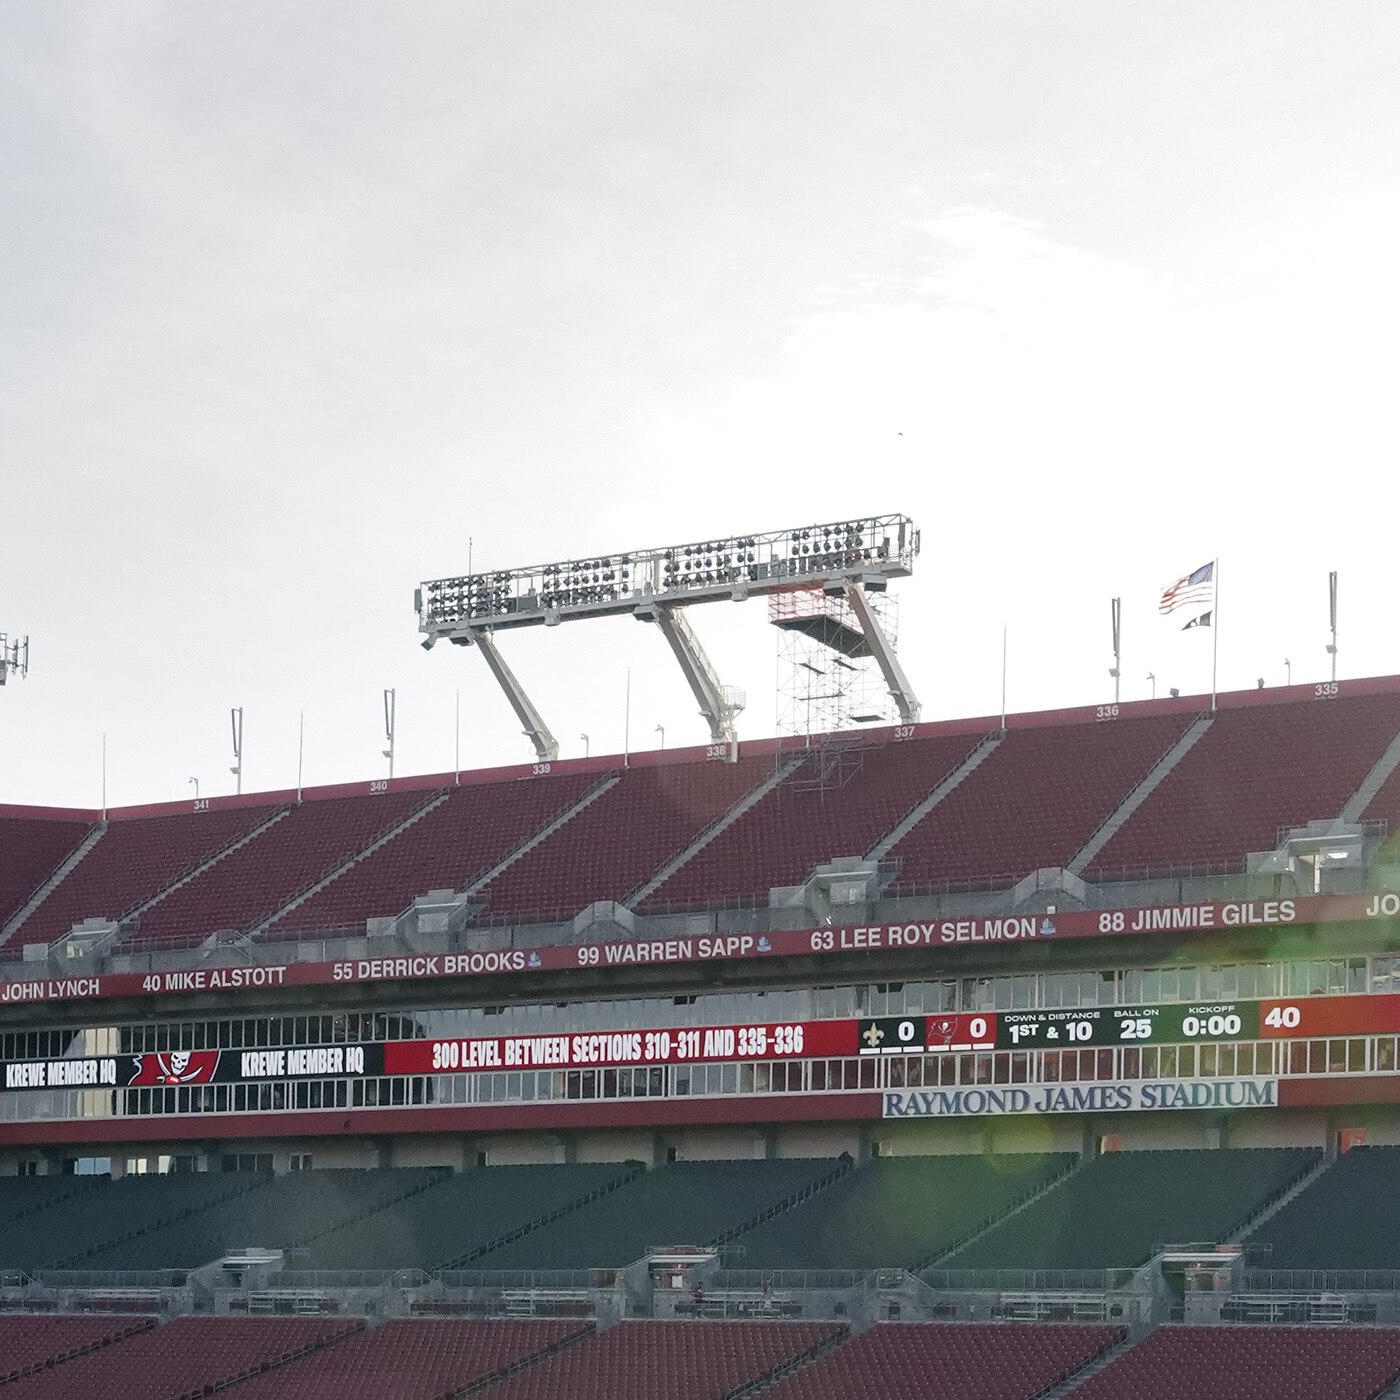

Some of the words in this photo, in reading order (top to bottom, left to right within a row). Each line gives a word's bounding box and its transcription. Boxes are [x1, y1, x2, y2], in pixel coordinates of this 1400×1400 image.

[1314, 683, 1339, 696] 335
[1096, 705, 1119, 717] 336
[894, 725, 916, 738] 337
[532, 764, 551, 775] 339
[369, 781, 388, 792] 340
[193, 800, 210, 811] 341
[1098, 911, 1125, 933] 88
[1132, 905, 1215, 930] JIMMIE
[1221, 900, 1296, 926] GILES
[811, 930, 835, 950] 63
[840, 927, 882, 949] LEE
[888, 923, 935, 946] ROY
[940, 917, 1037, 943] SELMON
[577, 946, 600, 965] 99
[605, 940, 692, 963] WARREN
[697, 935, 754, 957] SAPP
[332, 962, 353, 981] 55
[358, 956, 439, 979] DERRICK
[444, 950, 525, 974] BROOKS
[2, 982, 44, 1001] JOHN
[48, 978, 100, 999] LYNCH
[142, 975, 160, 992] 40
[165, 970, 208, 990] MIKE
[209, 965, 287, 988] ALSTOTT
[1004, 1014, 1037, 1023] DOWN
[1049, 1011, 1101, 1020] DISTANCE
[1113, 1009, 1136, 1018] BALL
[1139, 1007, 1160, 1016] ON
[1188, 1004, 1235, 1014] KICKOFF
[1264, 1006, 1301, 1029] 40
[897, 1021, 915, 1042] 0
[969, 1018, 987, 1039] 0
[1008, 1023, 1038, 1044] 1ST
[1046, 1027, 1059, 1040] &
[1066, 1021, 1093, 1041] 10
[1120, 1018, 1152, 1039] 25
[1182, 1014, 1242, 1037] 0:00
[432, 1042, 459, 1069] 300
[461, 1040, 502, 1067] LEVEL
[505, 1037, 569, 1066] BETWEEN
[572, 1033, 642, 1063] SECTIONS
[645, 1030, 700, 1060] 310-311
[703, 1028, 735, 1057] AND
[737, 1025, 804, 1055] 335-336
[6, 1061, 46, 1088] KREWE
[47, 1059, 98, 1086] MEMBER
[100, 1058, 117, 1085] HQ
[241, 1050, 285, 1077] KREWE
[287, 1047, 344, 1075] MEMBER
[346, 1046, 364, 1074] HQ
[885, 1088, 1030, 1116] RAYMOND
[1034, 1084, 1133, 1114] JAMES
[1140, 1080, 1277, 1111] STADIUM
